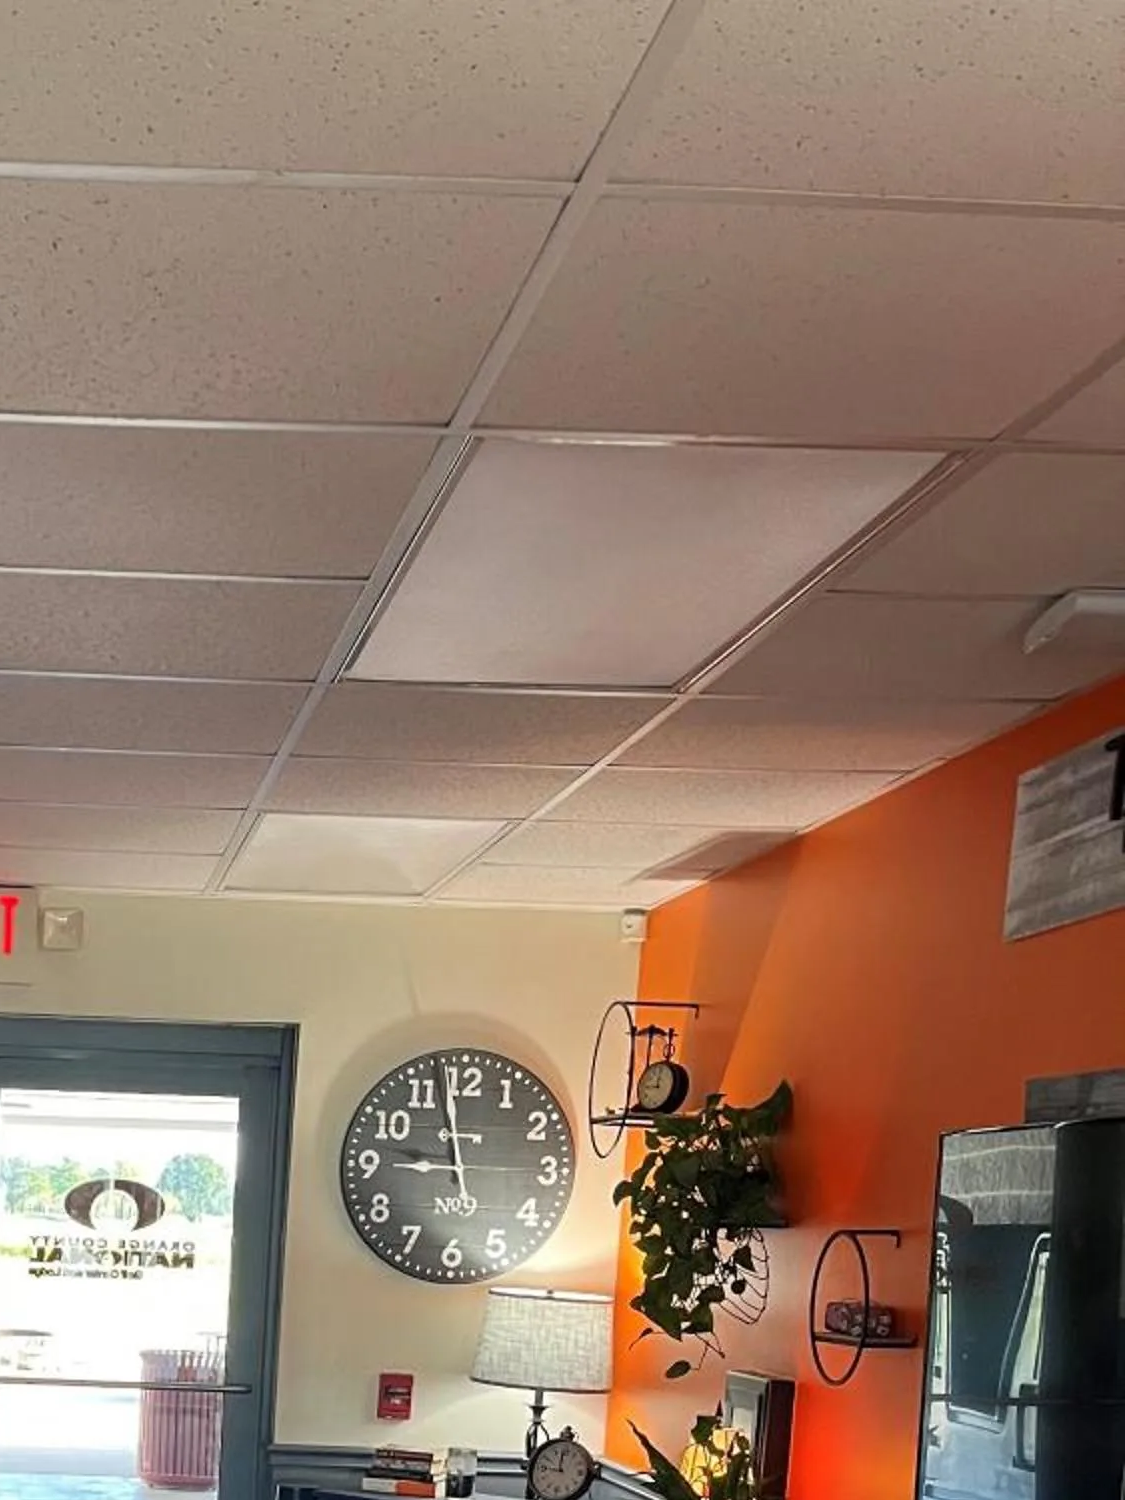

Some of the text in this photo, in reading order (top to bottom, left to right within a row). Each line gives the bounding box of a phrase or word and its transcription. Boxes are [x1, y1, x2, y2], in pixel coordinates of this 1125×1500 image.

[407, 1079, 436, 1109] 11
[448, 1066, 483, 1097] 12
[499, 1079, 513, 1109] 1
[374, 1110, 410, 1141] 10
[527, 1111, 548, 1141] 2
[358, 1150, 380, 1179] 9
[537, 1156, 558, 1186] 3
[370, 1193, 390, 1223] 8
[516, 1197, 539, 1227] 4
[401, 1225, 422, 1254] 7
[441, 1239, 462, 1268] 6
[484, 1229, 507, 1258] 5
